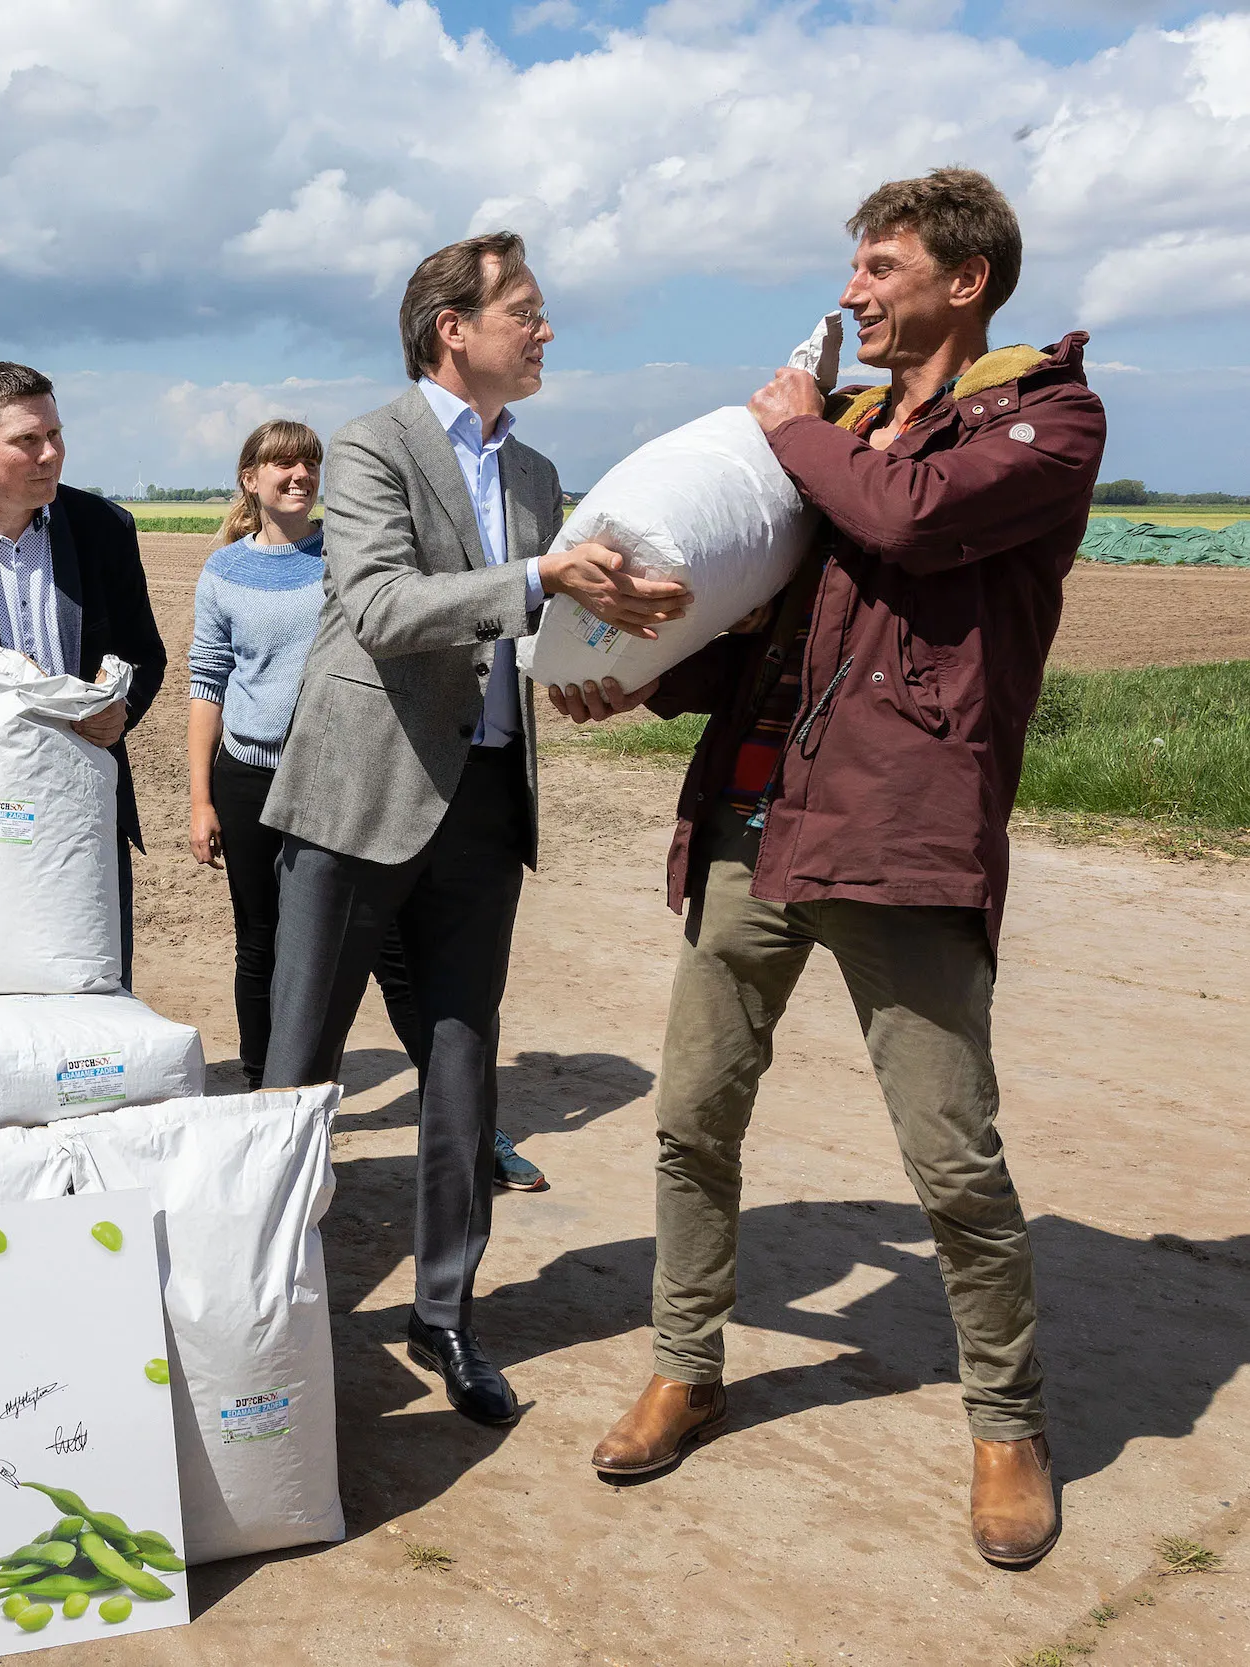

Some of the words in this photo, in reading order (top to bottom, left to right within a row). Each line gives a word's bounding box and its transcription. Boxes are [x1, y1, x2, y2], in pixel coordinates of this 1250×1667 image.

[61, 1070, 95, 1080] EDAMAME
[96, 1066, 119, 1076] ZADEN
[227, 1407, 261, 1418] EDAMAME
[262, 1399, 284, 1411] ZADEN
